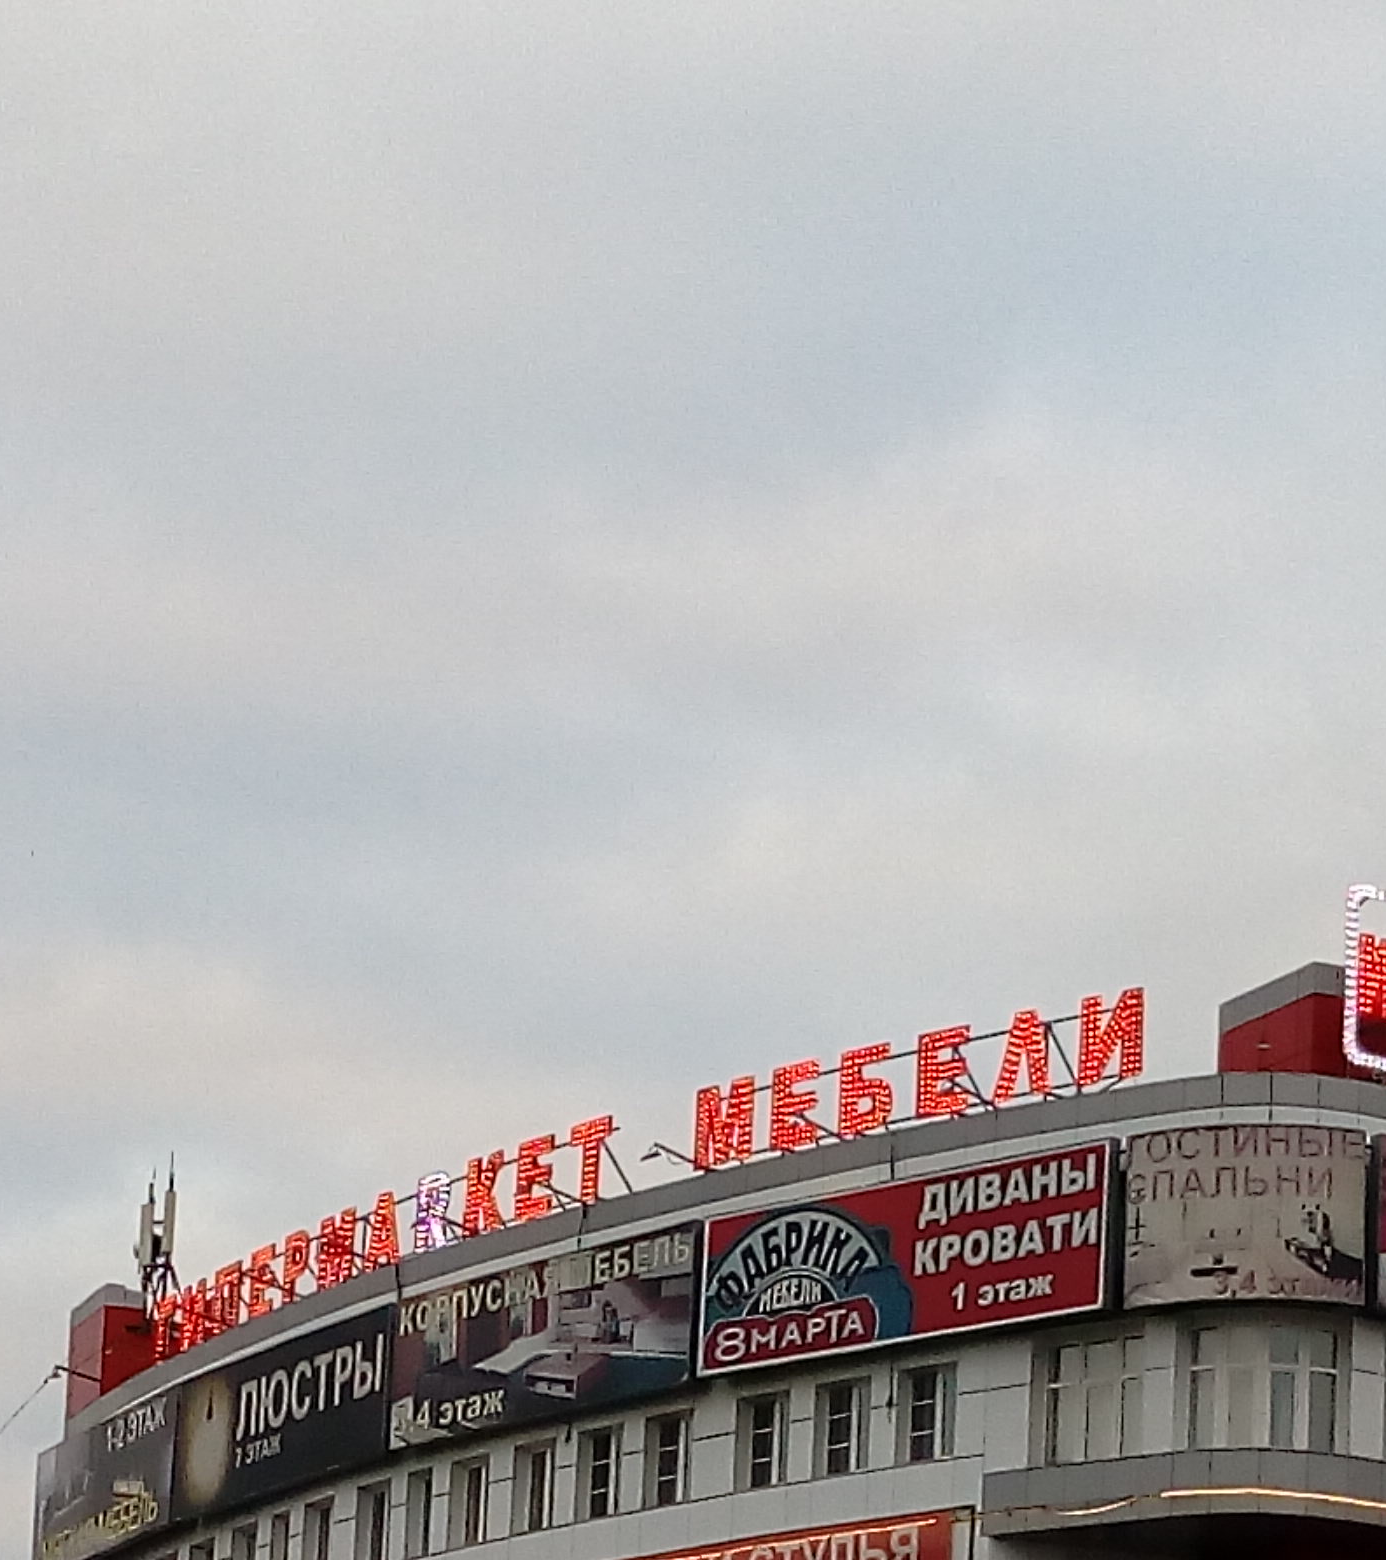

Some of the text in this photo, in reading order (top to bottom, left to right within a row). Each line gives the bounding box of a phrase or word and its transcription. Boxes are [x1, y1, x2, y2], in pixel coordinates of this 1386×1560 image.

[694, 987, 1145, 1172] МЕБЕЛИ
[918, 1153, 1097, 1230] ДИВАНЫ
[1128, 1164, 1333, 1205] СПАЛЬНИ
[716, 1219, 870, 1311] ФАБРИКА
[914, 1207, 1099, 1277] КРОВАТИ
[398, 1260, 560, 1337] КОРПУСНАЯ
[758, 1278, 822, 1314] МЕБЕЛИ
[951, 1274, 1054, 1310] 1 этаж
[235, 1333, 384, 1442] ЛЮСТРЫ
[438, 1387, 505, 1425] этаж
